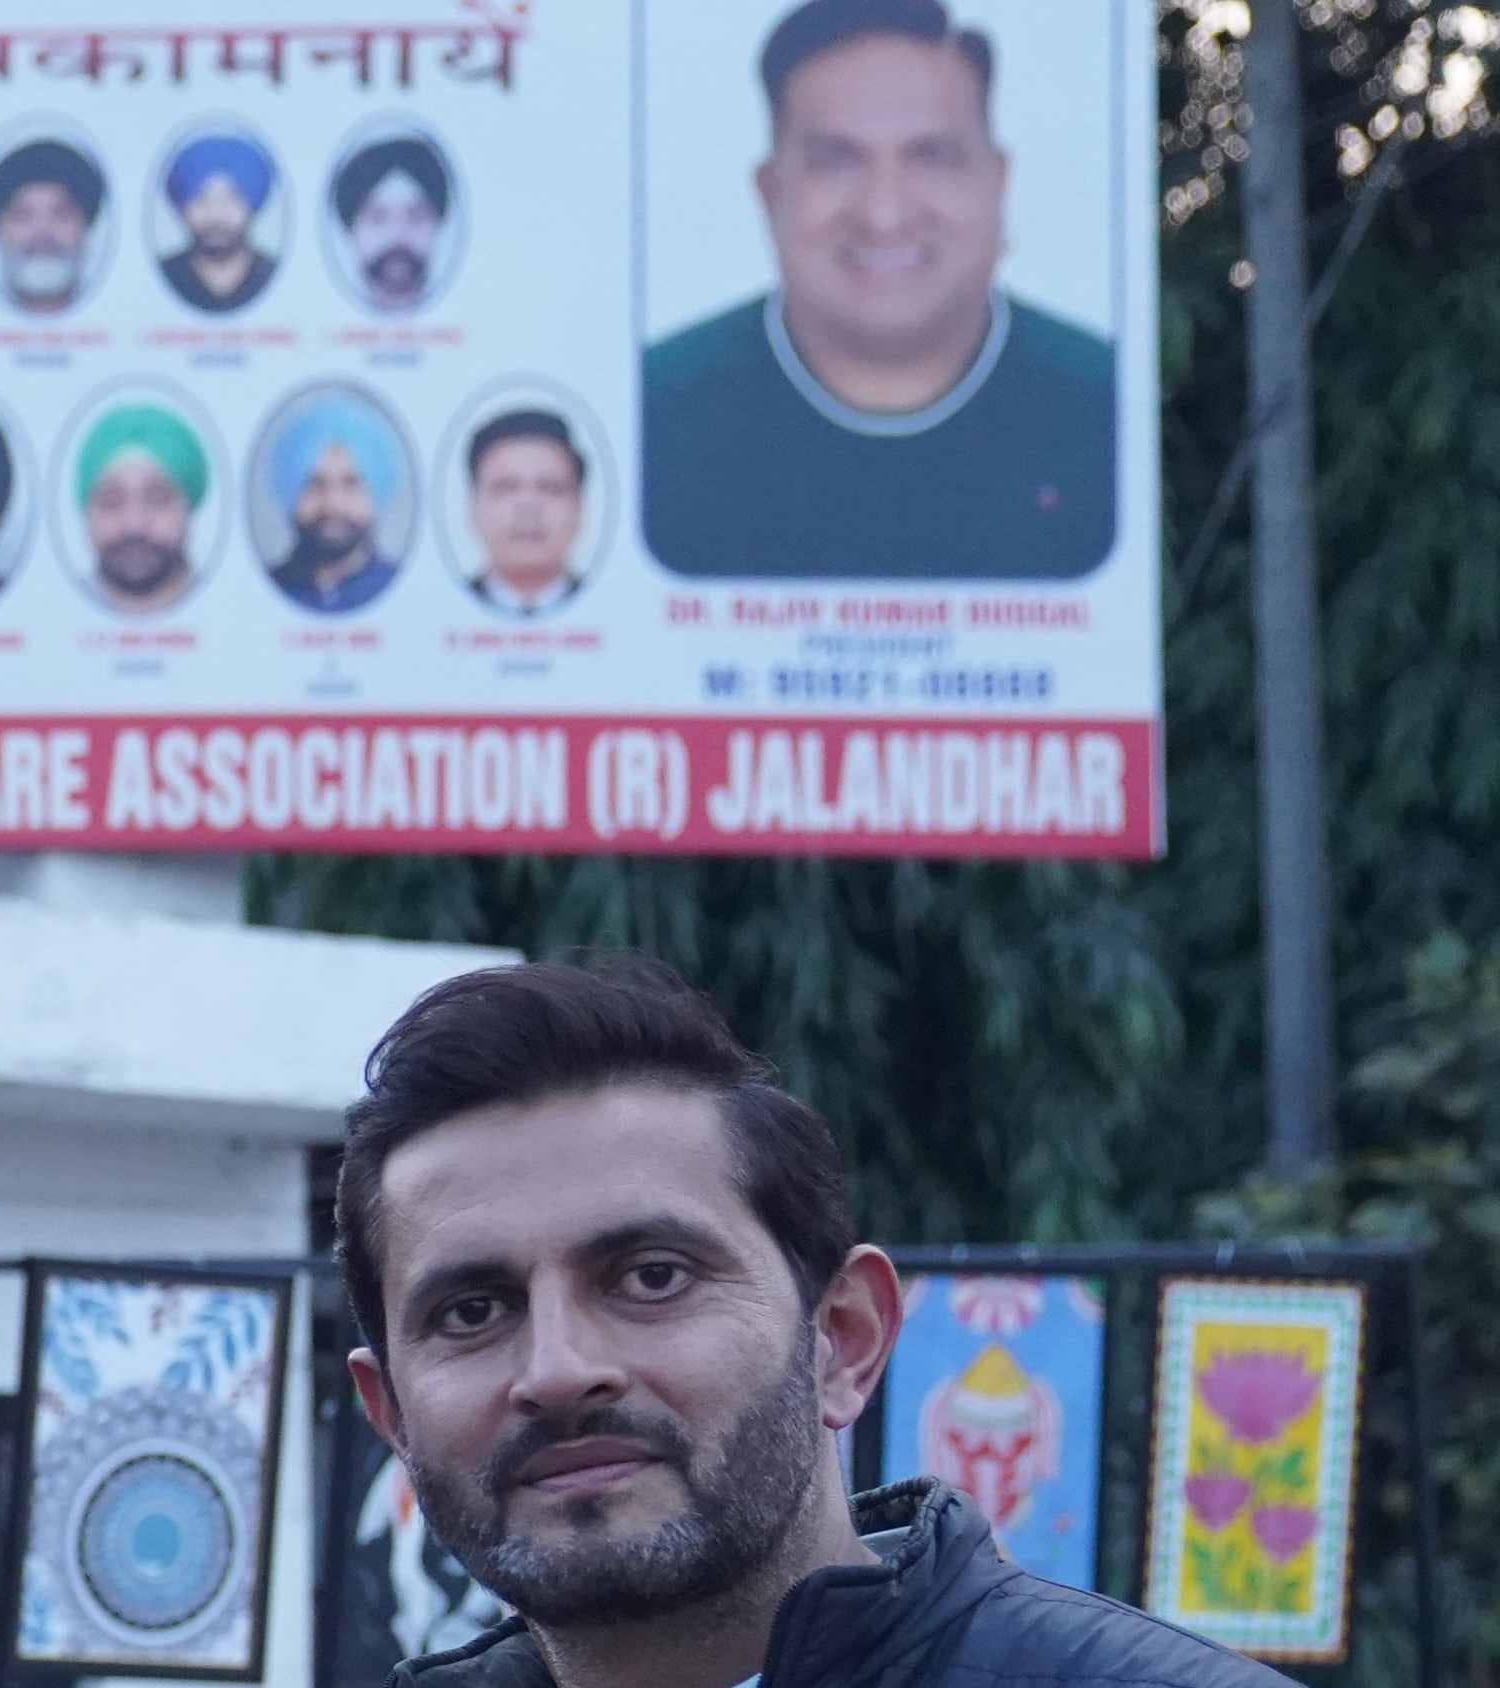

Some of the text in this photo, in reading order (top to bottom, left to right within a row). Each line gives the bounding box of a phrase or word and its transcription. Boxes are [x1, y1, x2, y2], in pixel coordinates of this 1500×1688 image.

[104, 727, 567, 830] ASSOCIATION
[587, 729, 690, 838] (R)
[706, 731, 1128, 834] JALANDHAR
